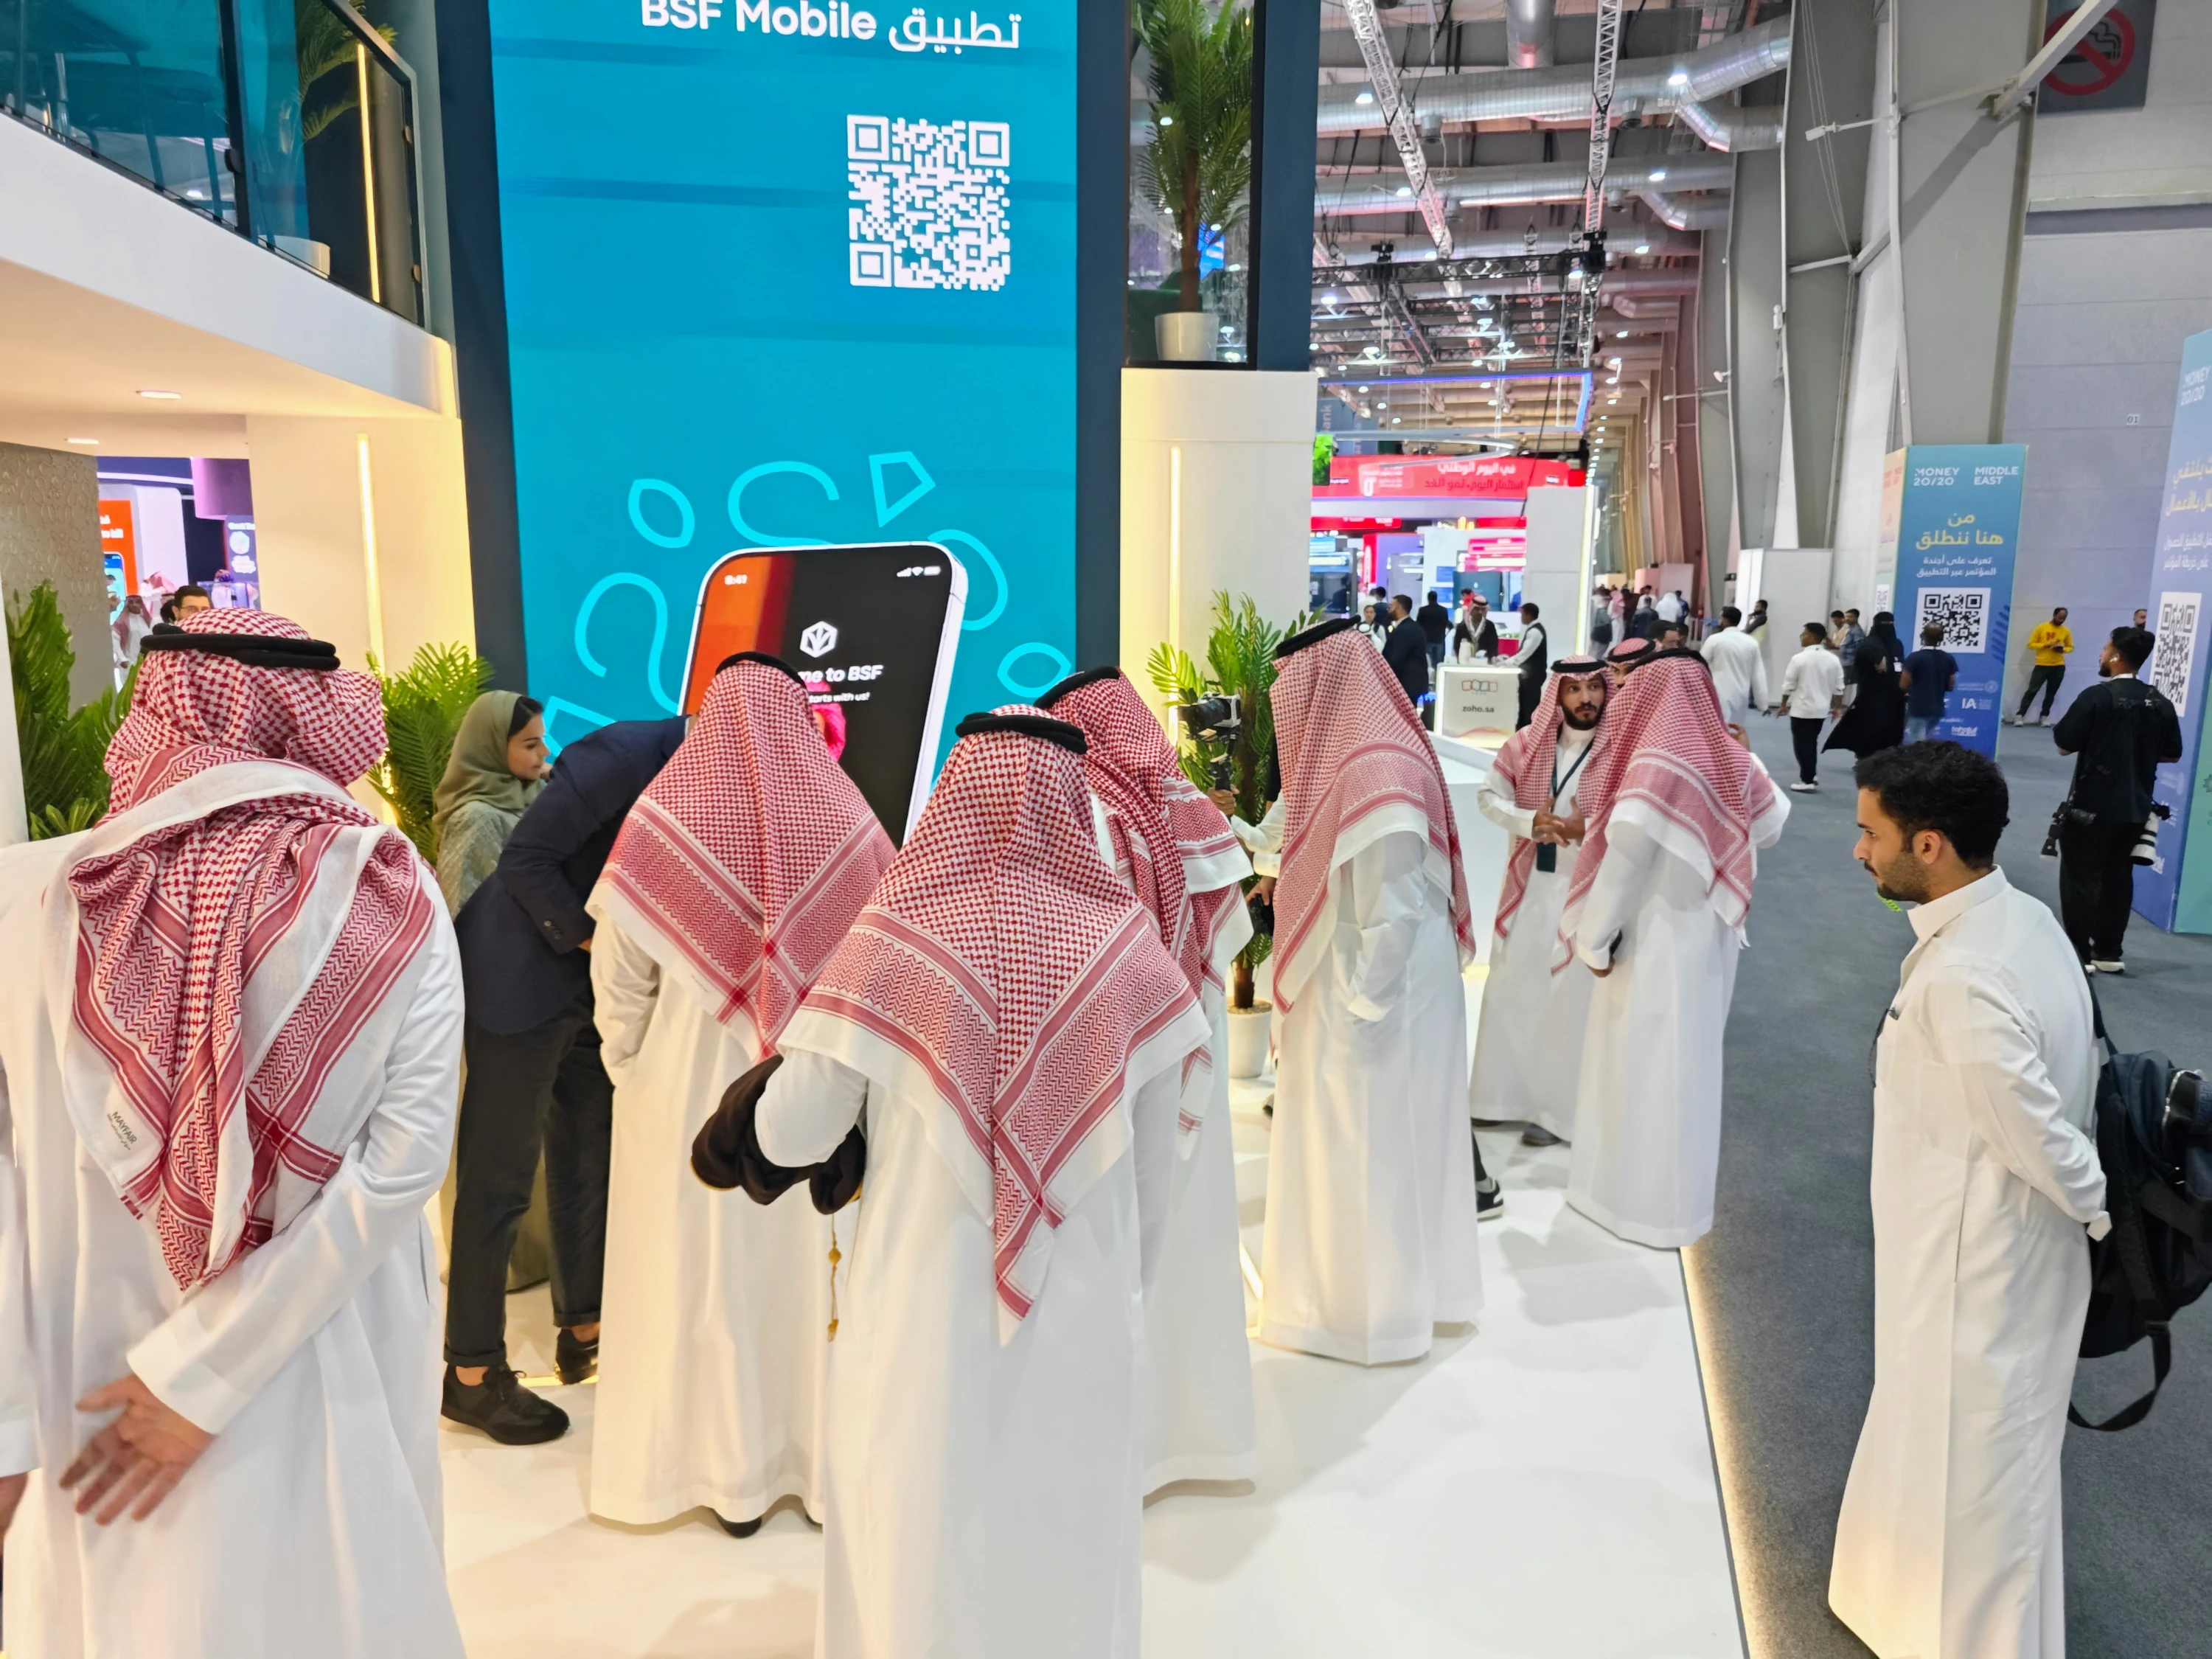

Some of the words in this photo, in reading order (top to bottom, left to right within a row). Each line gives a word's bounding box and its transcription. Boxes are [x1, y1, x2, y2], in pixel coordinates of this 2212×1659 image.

[641, 0, 723, 30] BSF
[736, 0, 877, 40] Mobile
[888, 7, 1022, 55] تطبيق
[1914, 467, 1960, 476] MONEY
[1975, 466, 2019, 476] MIDDLE
[1913, 478, 1954, 487] 20/20
[1974, 476, 2003, 485] EAST
[1947, 512, 1975, 527] من
[1916, 529, 1969, 550] ننطلق
[1976, 529, 2003, 545] هنا
[1916, 567, 1949, 578] التطبيق
[825, 667, 846, 682] to
[847, 664, 884, 681] BSF
[808, 695, 832, 703] tarts
[833, 692, 854, 702] with
[1462, 704, 1495, 713] zoho.sa
[112, 1111, 137, 1144] MAYFAIR
